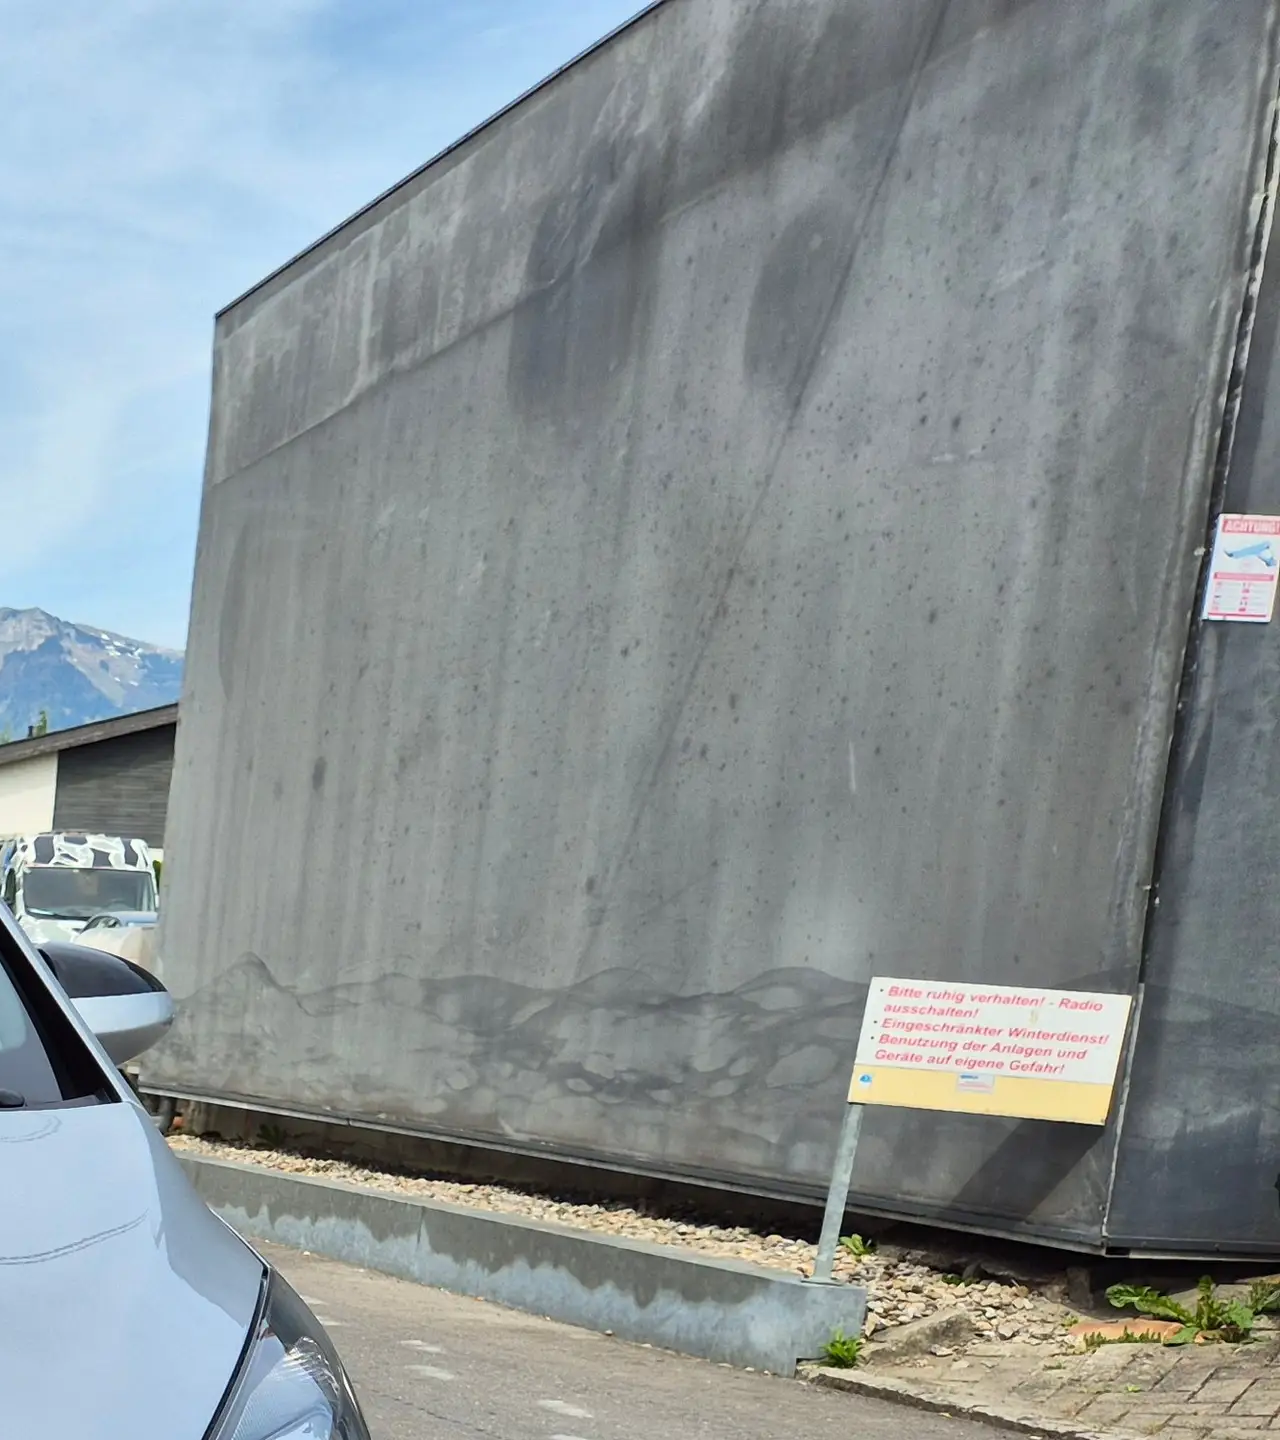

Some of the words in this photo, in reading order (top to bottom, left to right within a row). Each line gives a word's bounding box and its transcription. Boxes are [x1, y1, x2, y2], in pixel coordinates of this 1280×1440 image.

[883, 1004, 979, 1018] ausschalten!
[888, 985, 922, 998] Bitte
[927, 989, 965, 1003] ruhig
[970, 993, 1046, 1008] verhalten!
[1058, 997, 1103, 1011] Radio
[881, 1018, 1003, 1037] Eingeschränkter
[1008, 1027, 1110, 1045] Winterdienst!
[878, 1033, 958, 1052] Benutzung
[962, 1040, 987, 1052] der
[989, 1042, 1052, 1057] Anlagen
[1056, 1049, 1088, 1060] und
[875, 1049, 923, 1063] Geräte
[926, 1055, 952, 1065] auf
[955, 1057, 1004, 1069] eigene
[1009, 1060, 1065, 1074] Gefahr!
